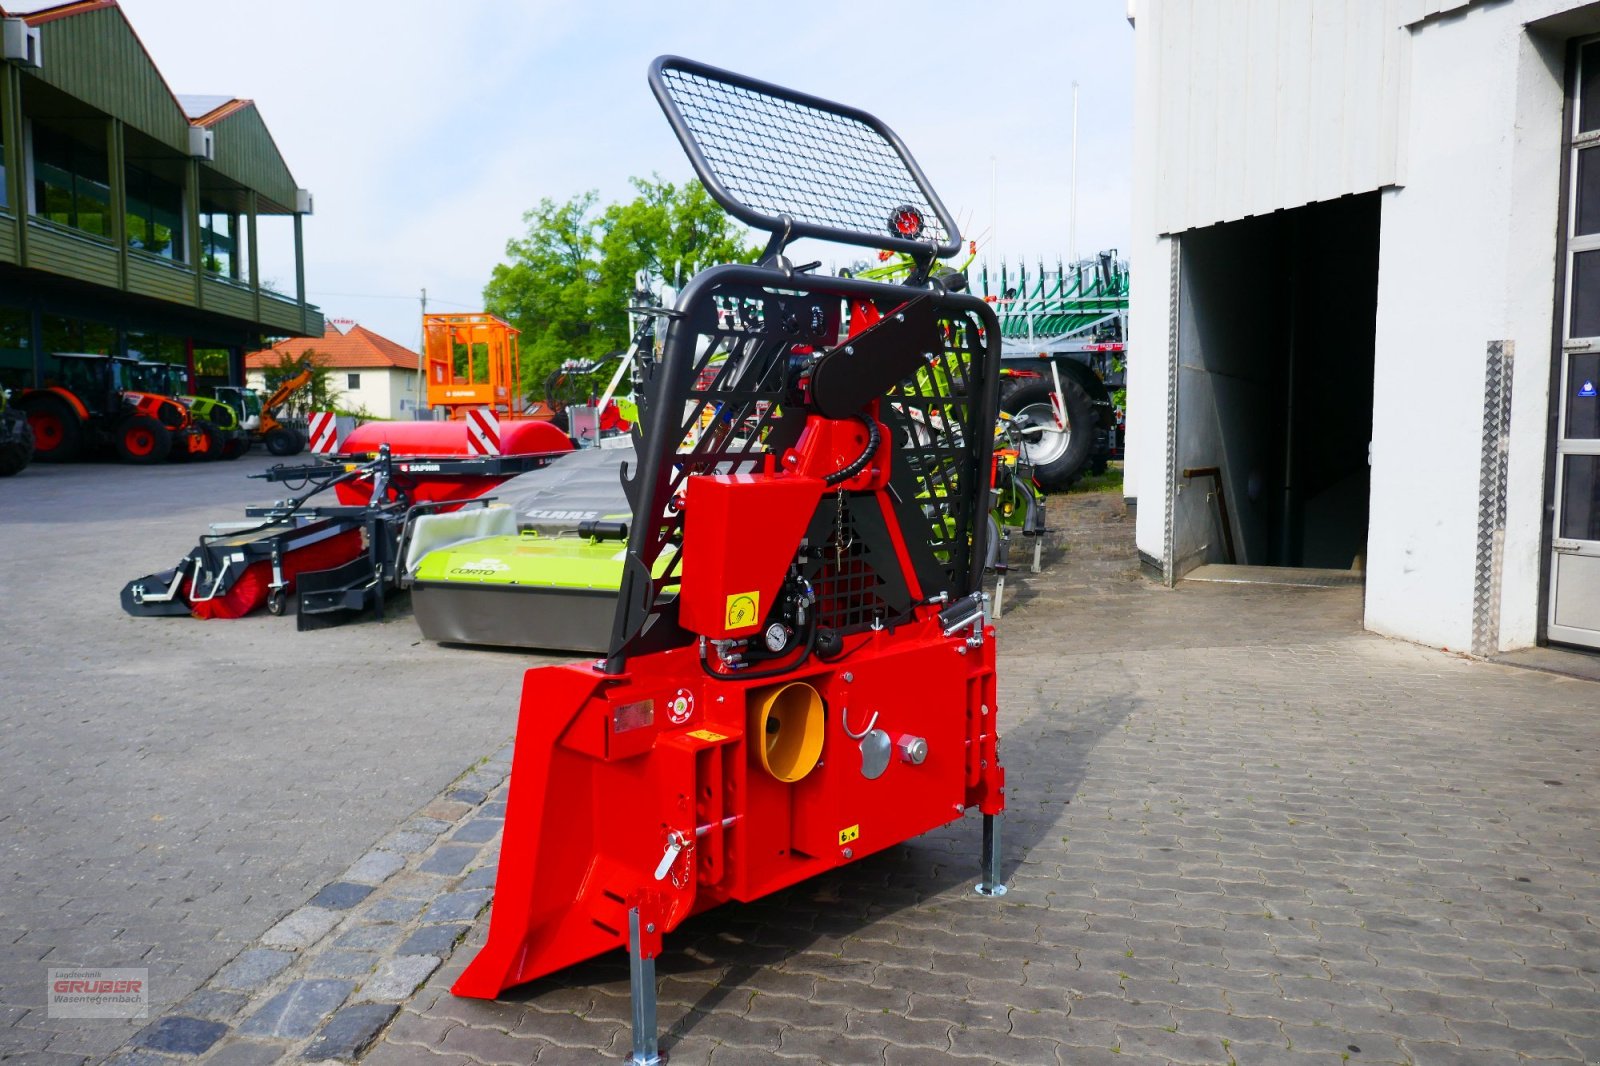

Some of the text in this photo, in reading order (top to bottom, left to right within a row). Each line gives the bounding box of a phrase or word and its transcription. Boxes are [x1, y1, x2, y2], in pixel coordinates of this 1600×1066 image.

[409, 464, 440, 472] SAPHIR
[525, 510, 598, 520] CLAAS
[450, 568, 495, 576] CORTO
